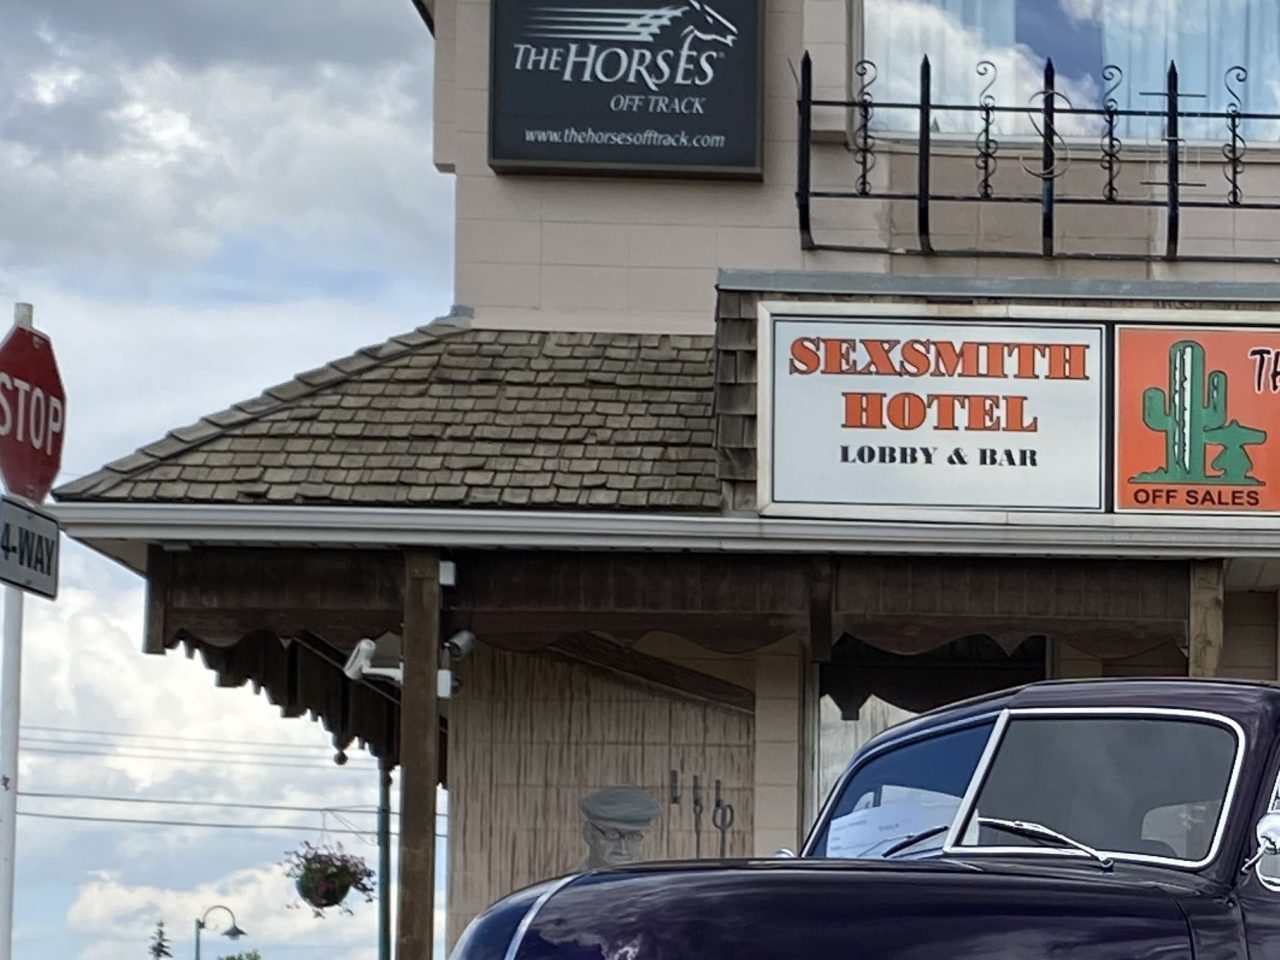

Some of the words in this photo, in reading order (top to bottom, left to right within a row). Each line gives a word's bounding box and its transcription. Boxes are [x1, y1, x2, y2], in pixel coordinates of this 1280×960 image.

[514, 44, 563, 70] THE
[562, 43, 717, 91] HORSES
[610, 94, 646, 111] OFF
[649, 95, 706, 114] TRACK
[525, 127, 725, 147] www.thehorsesofftrack.com
[789, 337, 1090, 380] SEXSMITH
[0, 371, 63, 456] STOP
[841, 392, 1038, 432] HOTEL
[840, 445, 939, 465] LOBBY
[947, 448, 968, 465] &
[979, 449, 1038, 467] BAR
[1133, 488, 1178, 504] OFF
[1185, 489, 1260, 506] SALES
[1, 522, 55, 576] 4-WAY
